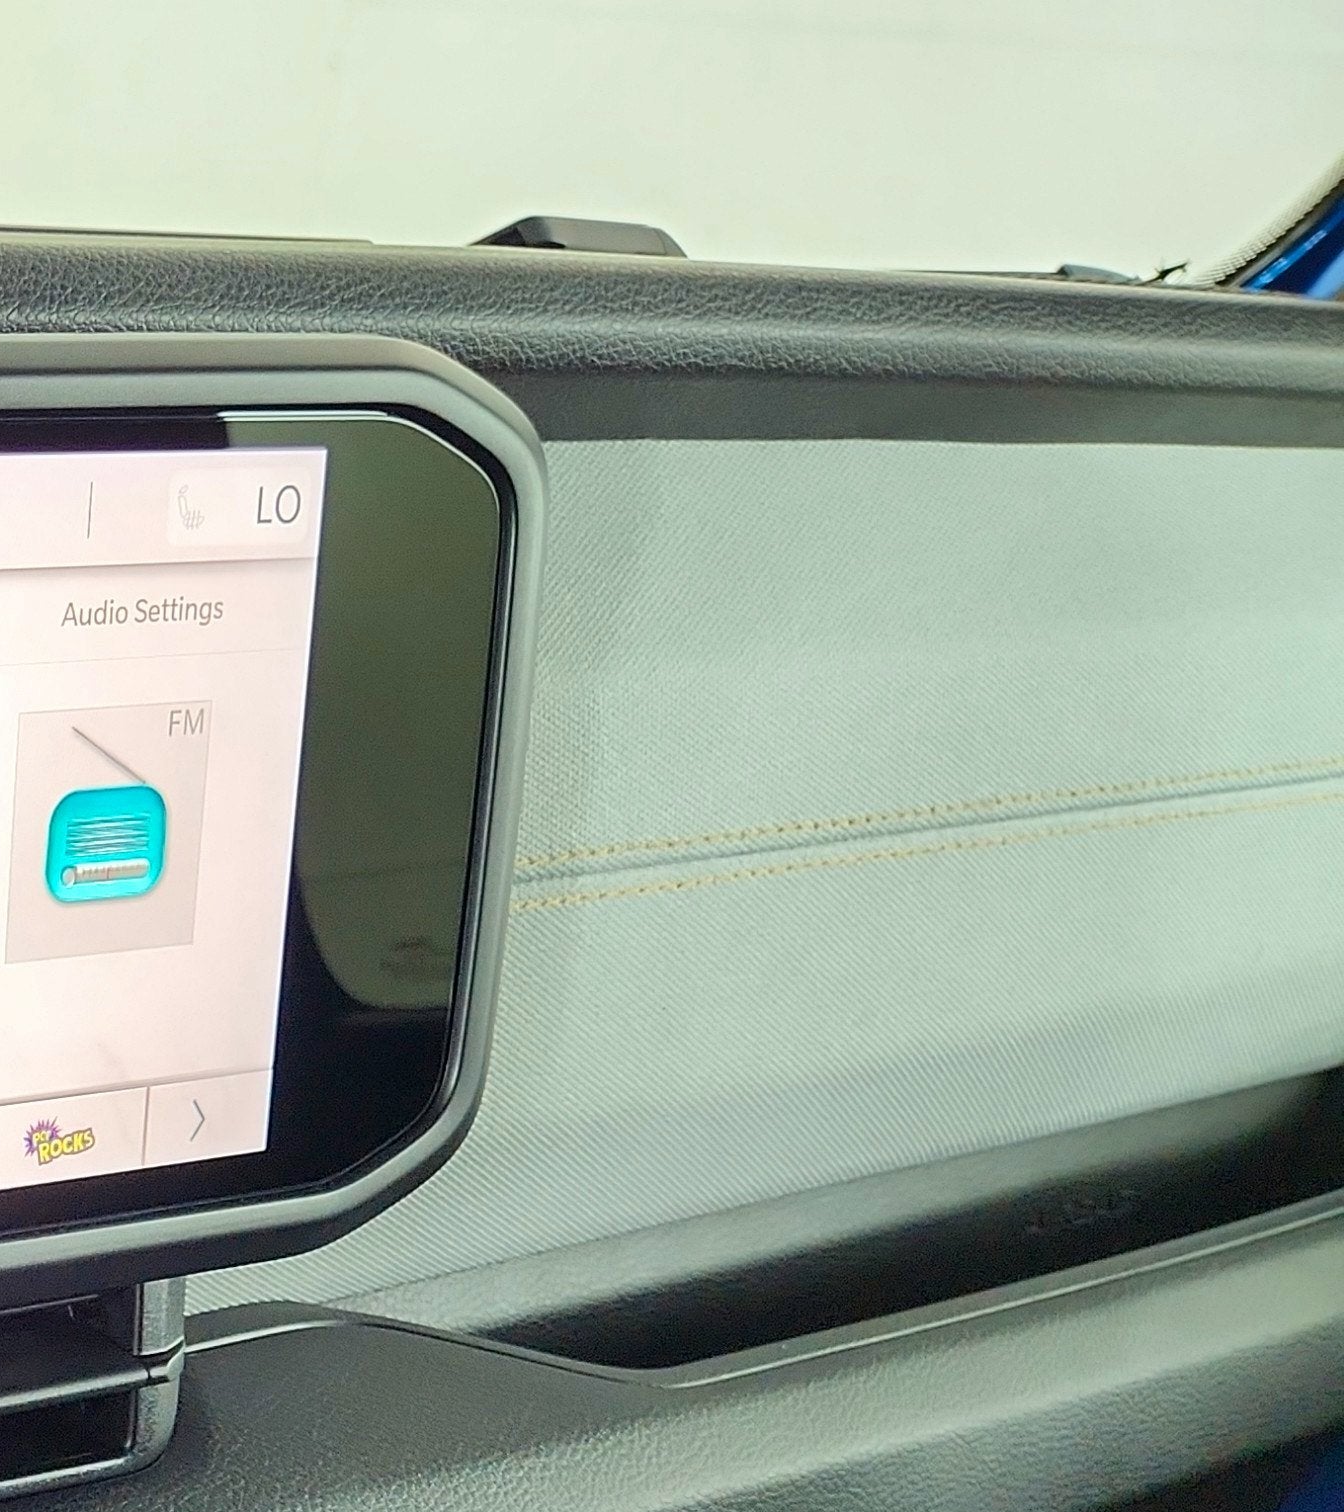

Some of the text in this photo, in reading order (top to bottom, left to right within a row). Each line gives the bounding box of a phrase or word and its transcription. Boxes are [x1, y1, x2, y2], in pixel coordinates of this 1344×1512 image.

[255, 484, 302, 526] LO
[60, 596, 225, 628] Audio Settings
[167, 708, 206, 738] FM
[37, 1128, 95, 1165] ROCKS
